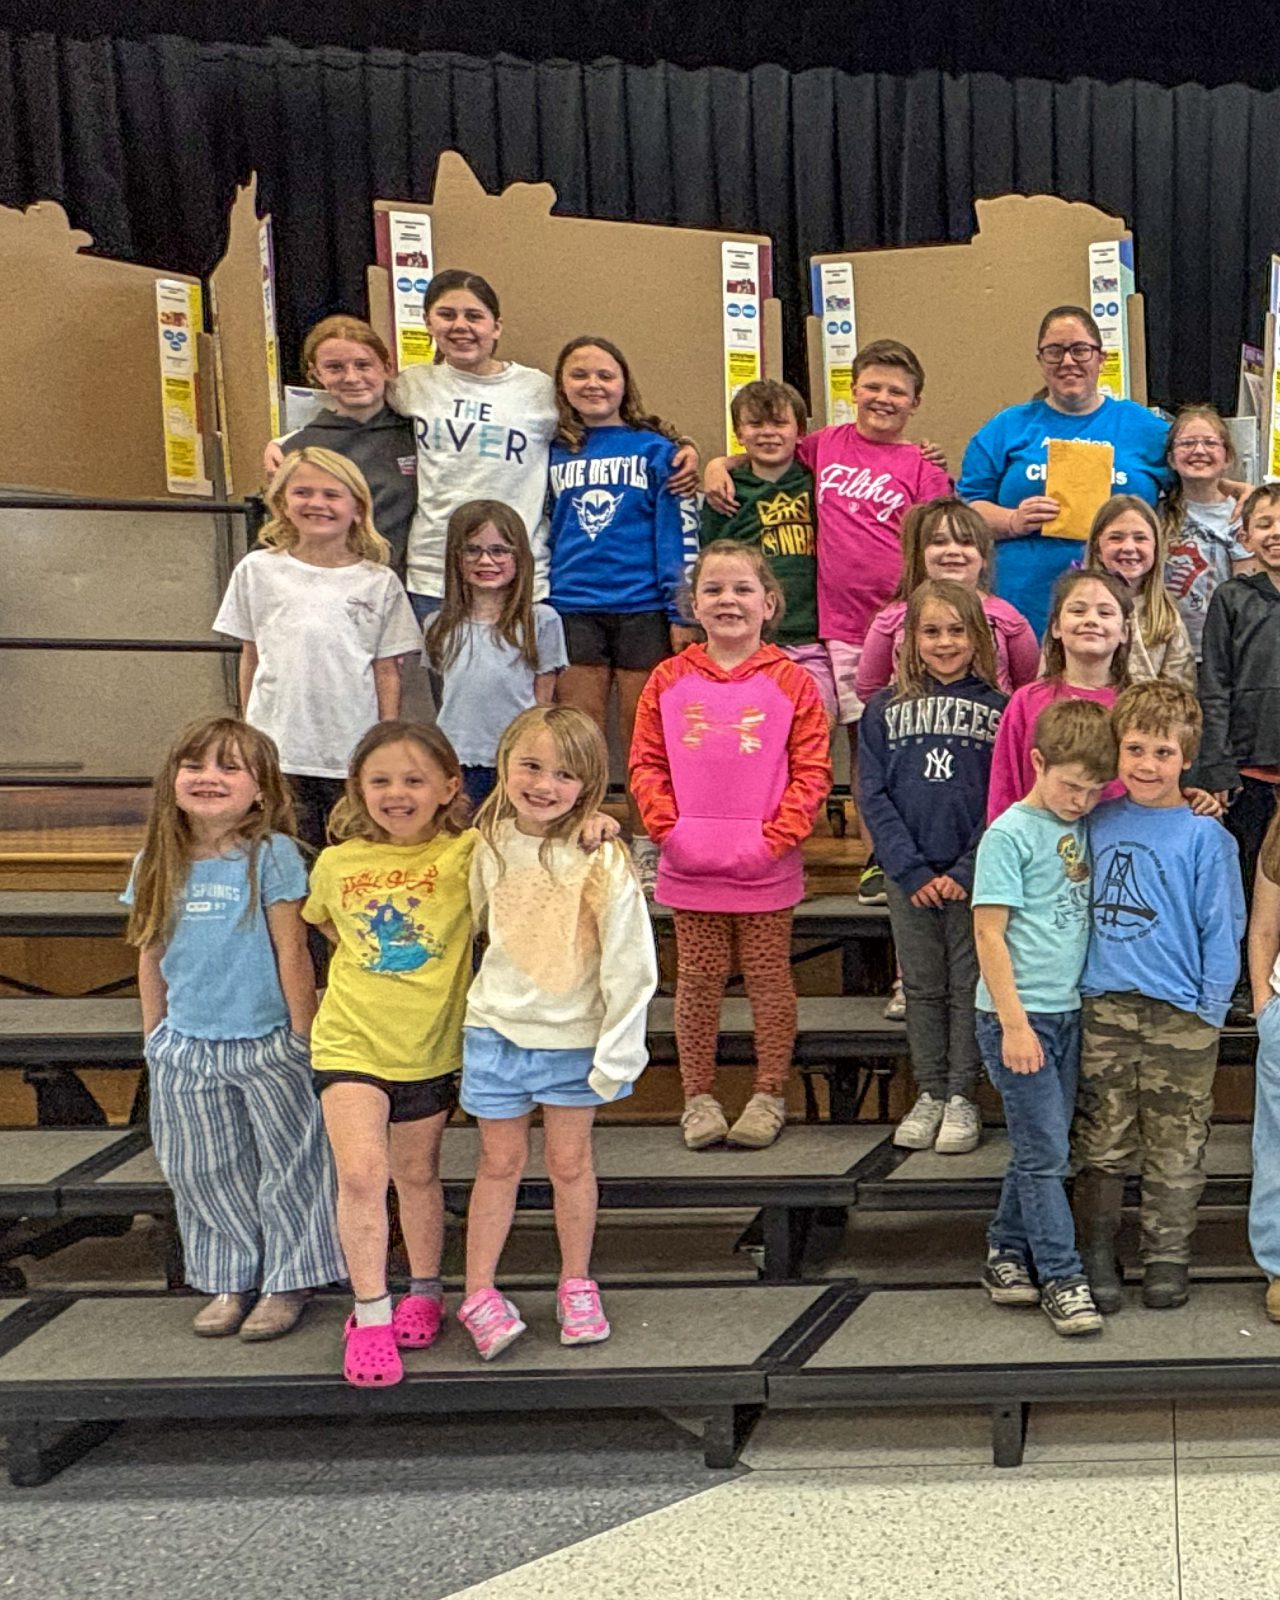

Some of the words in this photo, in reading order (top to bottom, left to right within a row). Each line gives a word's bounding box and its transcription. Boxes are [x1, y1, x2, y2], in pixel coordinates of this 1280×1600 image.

[453, 399, 492, 422] THE
[417, 416, 527, 465] RIVER
[550, 459, 587, 498] BLUE
[589, 455, 648, 490] DEVILS
[818, 462, 905, 522] Filthy
[778, 524, 815, 556] NBA
[885, 696, 1001, 743] YANKEES
